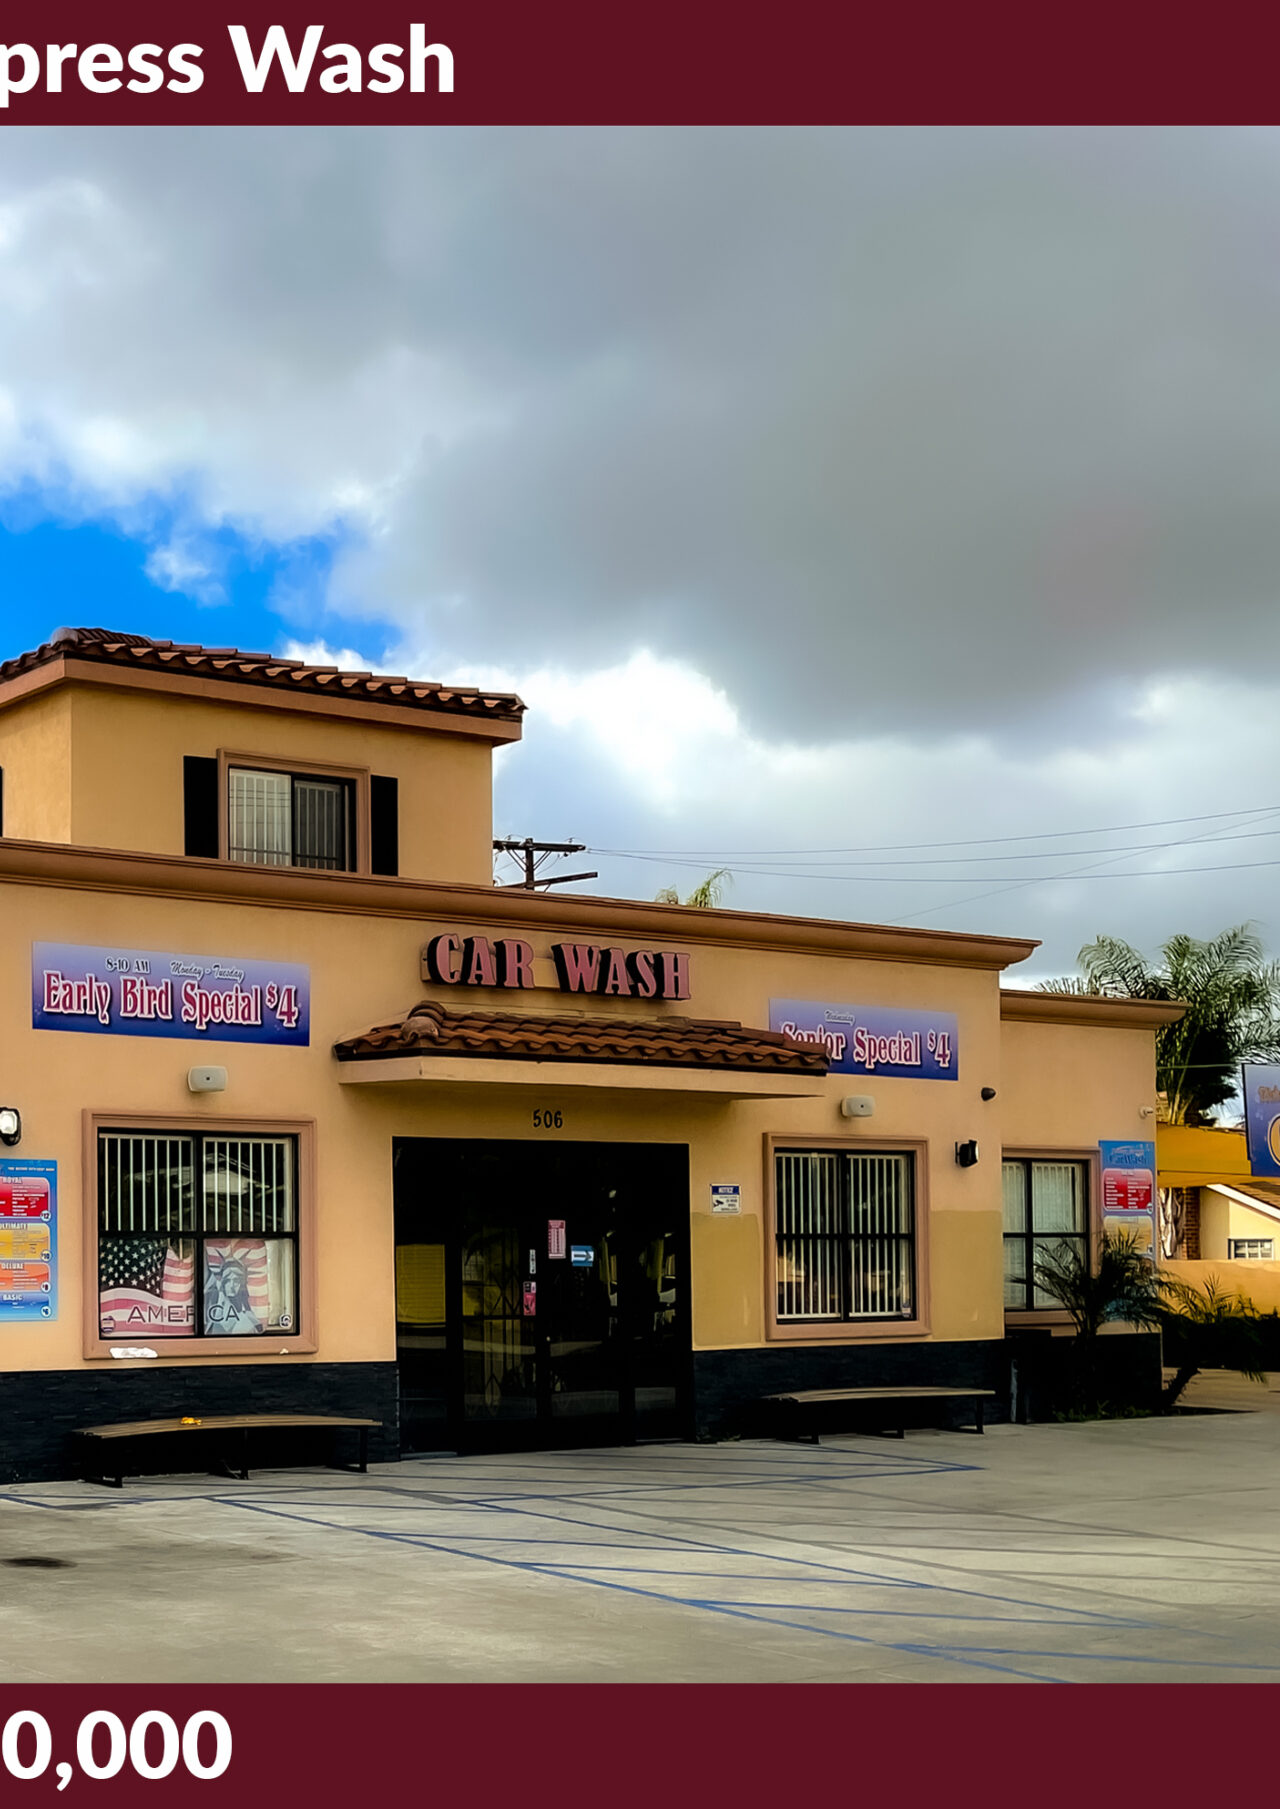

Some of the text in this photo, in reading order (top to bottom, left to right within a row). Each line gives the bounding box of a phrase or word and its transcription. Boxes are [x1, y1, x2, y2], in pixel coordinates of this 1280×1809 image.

[133, 958, 150, 974] AM
[169, 961, 204, 981] Monday
[212, 963, 246, 983] Tuesday
[427, 933, 692, 1000] CAR WASH
[43, 970, 299, 1030] Early Bird Special $4
[853, 1026, 921, 1070] Special
[927, 1028, 951, 1068] $4
[532, 1109, 564, 1129] 506
